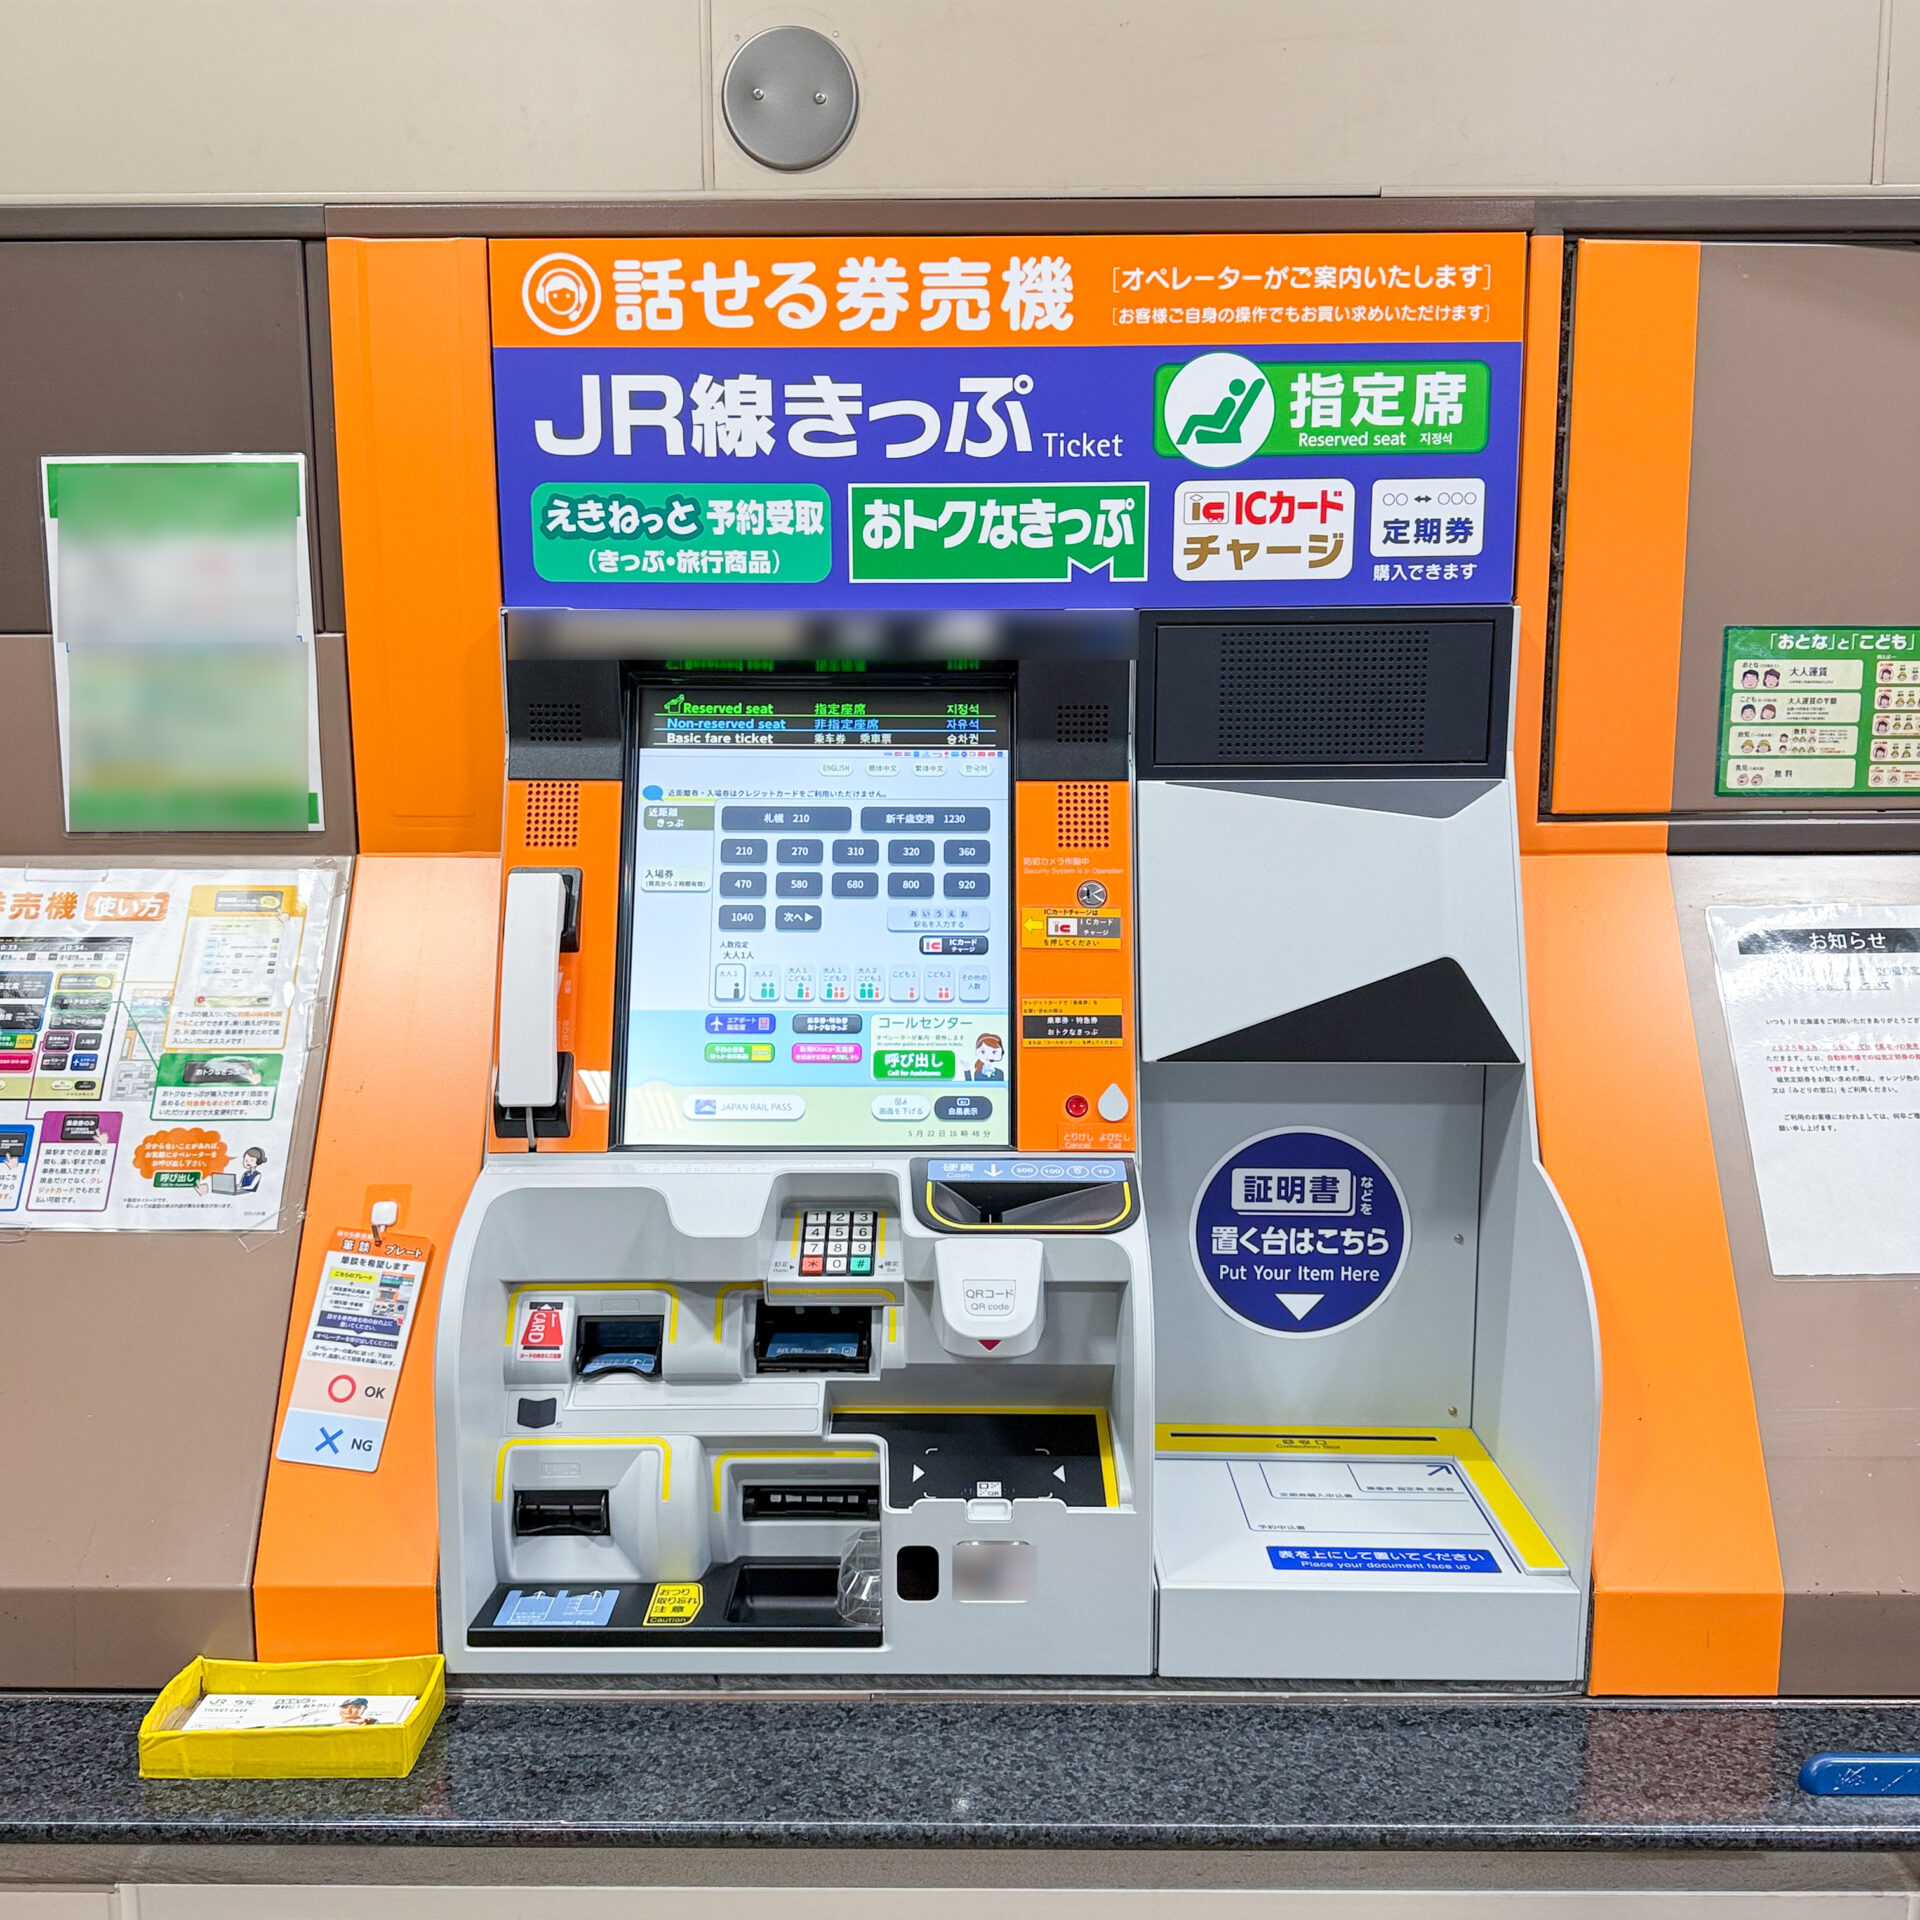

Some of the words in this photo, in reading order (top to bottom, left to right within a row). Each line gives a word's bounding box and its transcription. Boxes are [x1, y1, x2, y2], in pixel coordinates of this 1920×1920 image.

[612, 256, 1075, 333] 話せる券売機
[1289, 371, 1467, 429] 指定席
[535, 373, 1035, 459] JR線きっぷ
[1299, 431, 1369, 447] Reserved
[1373, 432, 1407, 446] seat
[1419, 431, 1454, 446] 지정석
[1042, 432, 1124, 458] Ticket
[1235, 490, 1345, 525] ICカード
[544, 499, 699, 536] えきねっと
[705, 499, 825, 535] 予約受取
[862, 498, 1136, 549] おトクなきっぷ
[1382, 518, 1475, 545] 定期券
[1183, 532, 1344, 571] チャージ
[1372, 562, 1477, 581] 購入できます
[1770, 633, 1915, 651] 「おとな」と「こども」
[683, 702, 742, 714] Reserved
[745, 703, 774, 714] seat
[814, 703, 866, 716] 指定座席
[946, 703, 980, 715] 지정석
[667, 718, 755, 729] Non-reserved
[758, 719, 787, 729] seat
[814, 719, 879, 730] 非指定座席
[946, 719, 980, 730] 자유석
[667, 732, 702, 743] Basic
[705, 732, 732, 743] fare
[735, 732, 774, 744] ticket
[946, 733, 980, 745] 승차권
[822, 764, 850, 772] ENGLISH
[648, 807, 679, 817] 近距離
[792, 814, 810, 823] 210
[886, 814, 936, 824] 新千歳空港
[943, 814, 966, 824] 1230
[735, 846, 753, 856] 210
[791, 846, 809, 856] 270
[847, 847, 865, 856] 310
[902, 847, 920, 856] 320
[958, 847, 976, 857] 360
[1023, 857, 1090, 866] 防犯カメラ作動中
[644, 869, 674, 879] 入場券
[734, 880, 752, 889] 470
[790, 880, 809, 889] 580
[847, 880, 864, 889] 680
[902, 880, 920, 889] 800
[958, 880, 976, 889] 920
[0, 891, 78, 920] 売機
[93, 896, 165, 918] 使い方
[731, 912, 754, 922] 1040
[1808, 932, 1886, 951] お知らせ
[878, 1016, 973, 1030] コールセンター
[1047, 1028, 1099, 1036] おトクなきっぷ
[884, 1052, 944, 1068] 呼び出し
[721, 1103, 748, 1111] JAPAN
[750, 1103, 769, 1111] RAIL
[771, 1103, 793, 1111] PASS
[1063, 1133, 1094, 1142] とりけし
[160, 1173, 195, 1182] 呼び出し
[1243, 1175, 1340, 1204] 証明書
[1360, 1176, 1374, 1216] などを
[836, 1212, 845, 1221] 2
[860, 1212, 868, 1221] 3
[811, 1228, 820, 1237] 4
[835, 1228, 844, 1236] 5
[859, 1228, 868, 1237] 6
[1211, 1226, 1390, 1255] 置く台はこちら
[385, 1244, 423, 1259] プレート
[810, 1243, 819, 1252] 7
[834, 1243, 842, 1253] 8
[858, 1243, 866, 1253] 9
[833, 1260, 842, 1269] 0
[1219, 1264, 1247, 1280] Put
[1253, 1265, 1292, 1280] Your
[1298, 1265, 1335, 1281] Item
[1341, 1266, 1380, 1281] Here
[965, 1287, 1014, 1299] QRコード
[971, 1302, 985, 1311] QR
[988, 1302, 1010, 1311] code
[528, 1312, 547, 1343] CARD
[364, 1386, 386, 1400] OK
[350, 1438, 373, 1452] NG
[1278, 1550, 1486, 1562] 表を上にして置いてください
[1301, 1561, 1334, 1569] Place
[1337, 1562, 1363, 1570] your
[1366, 1561, 1424, 1570] document
[1427, 1562, 1452, 1570] face
[659, 1588, 691, 1596] おつり
[656, 1596, 698, 1604] 取り忘れ
